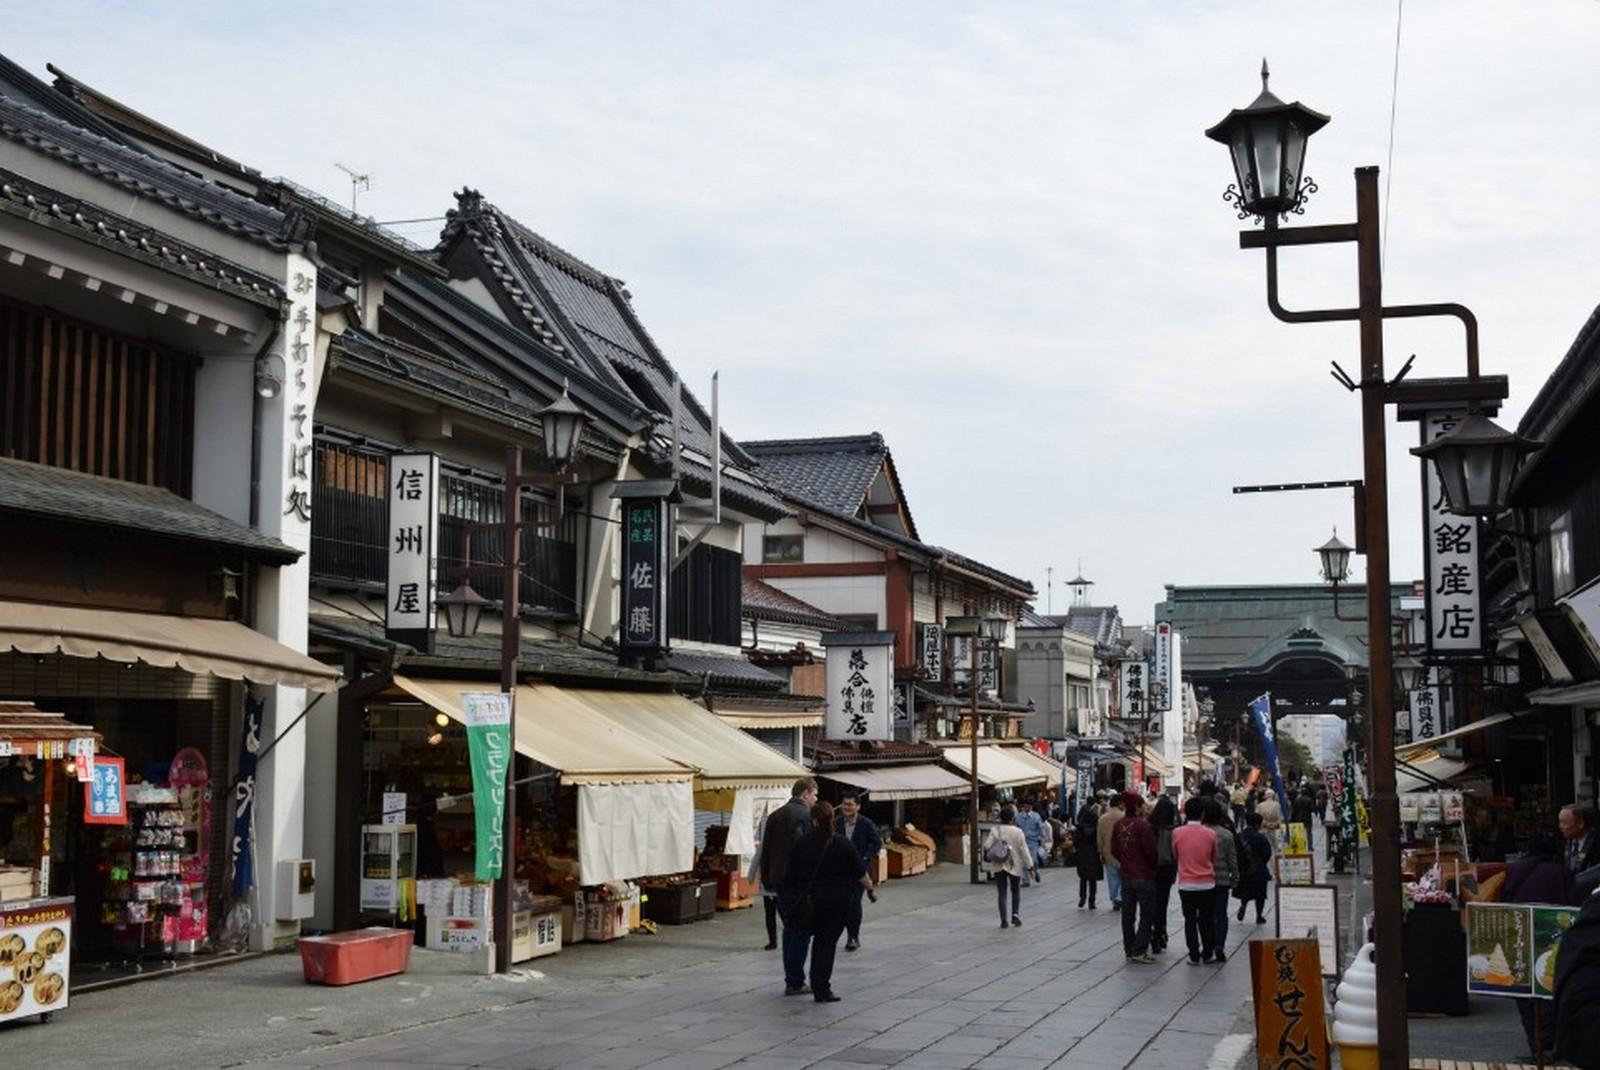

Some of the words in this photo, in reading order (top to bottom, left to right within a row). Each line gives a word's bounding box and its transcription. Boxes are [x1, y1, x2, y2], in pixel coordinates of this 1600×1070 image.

[393, 468, 424, 614] 信州屋
[629, 561, 654, 634] 佐藤
[846, 713, 868, 735] 店
